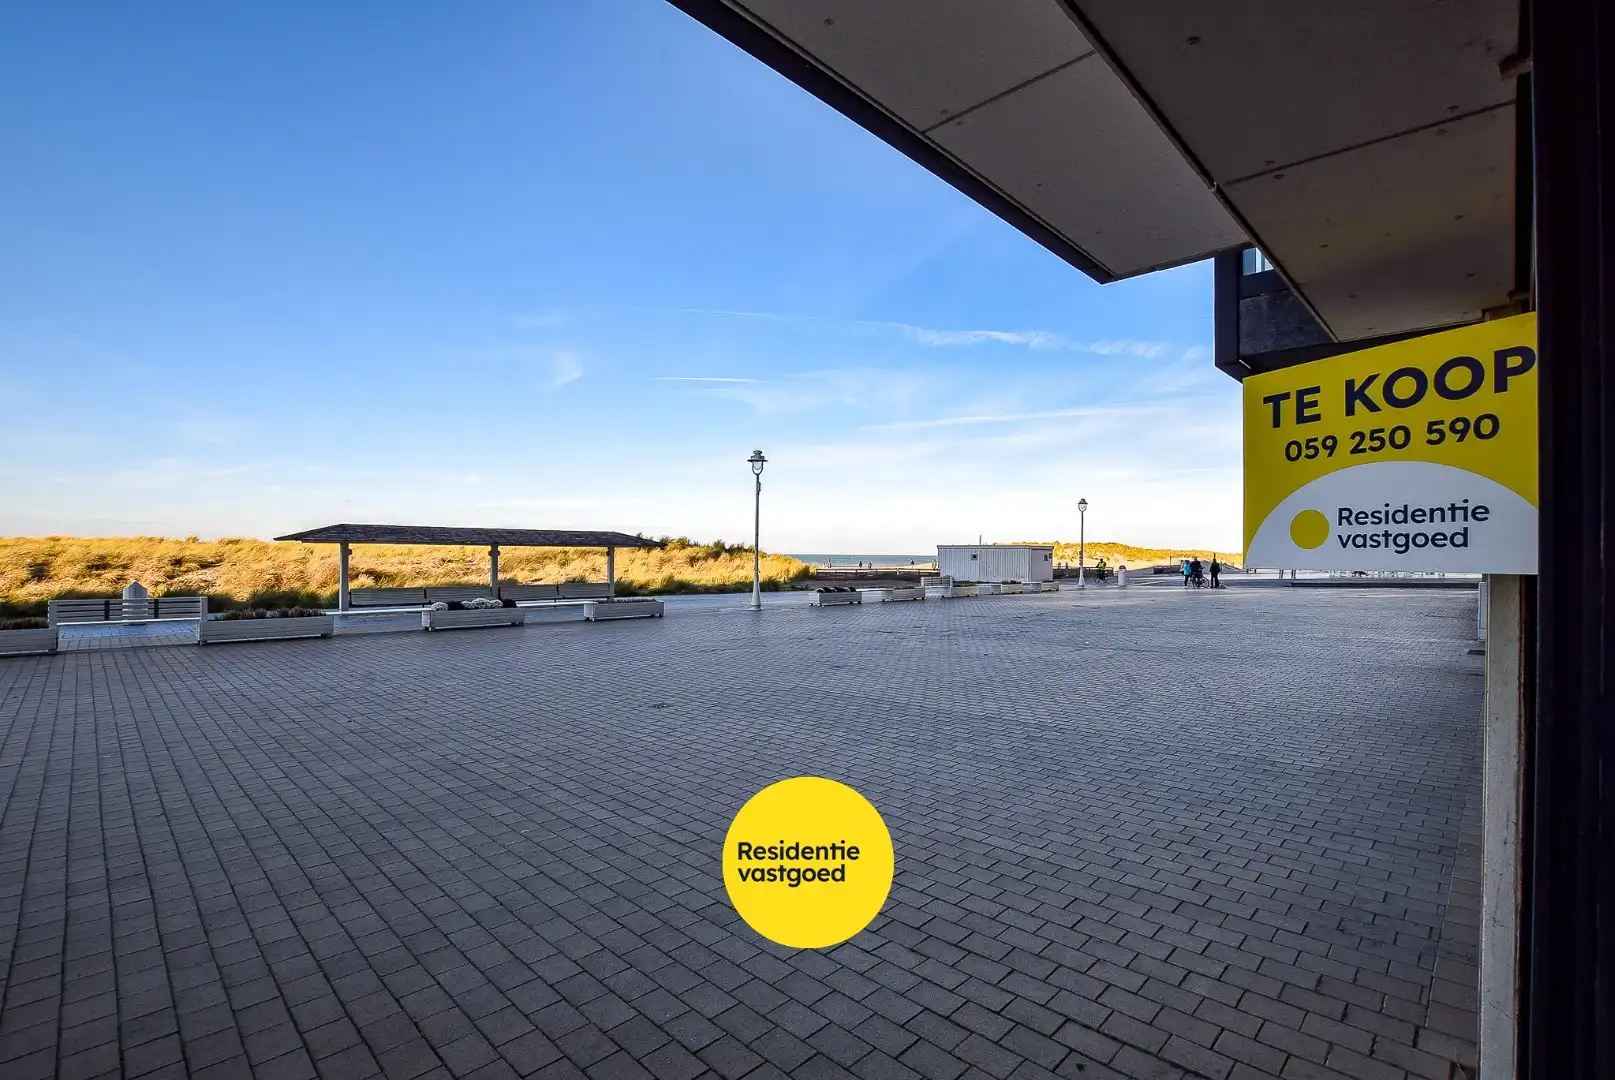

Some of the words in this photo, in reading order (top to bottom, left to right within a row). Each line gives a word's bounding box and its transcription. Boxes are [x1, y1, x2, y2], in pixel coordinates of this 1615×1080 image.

[1263, 385, 1321, 429] TE
[1344, 345, 1537, 417] KOOP
[1284, 434, 1338, 462] 059
[1349, 425, 1411, 455] 250
[1425, 413, 1500, 446] 590
[1337, 499, 1490, 526] Residentie
[1337, 527, 1469, 554] vastgoed
